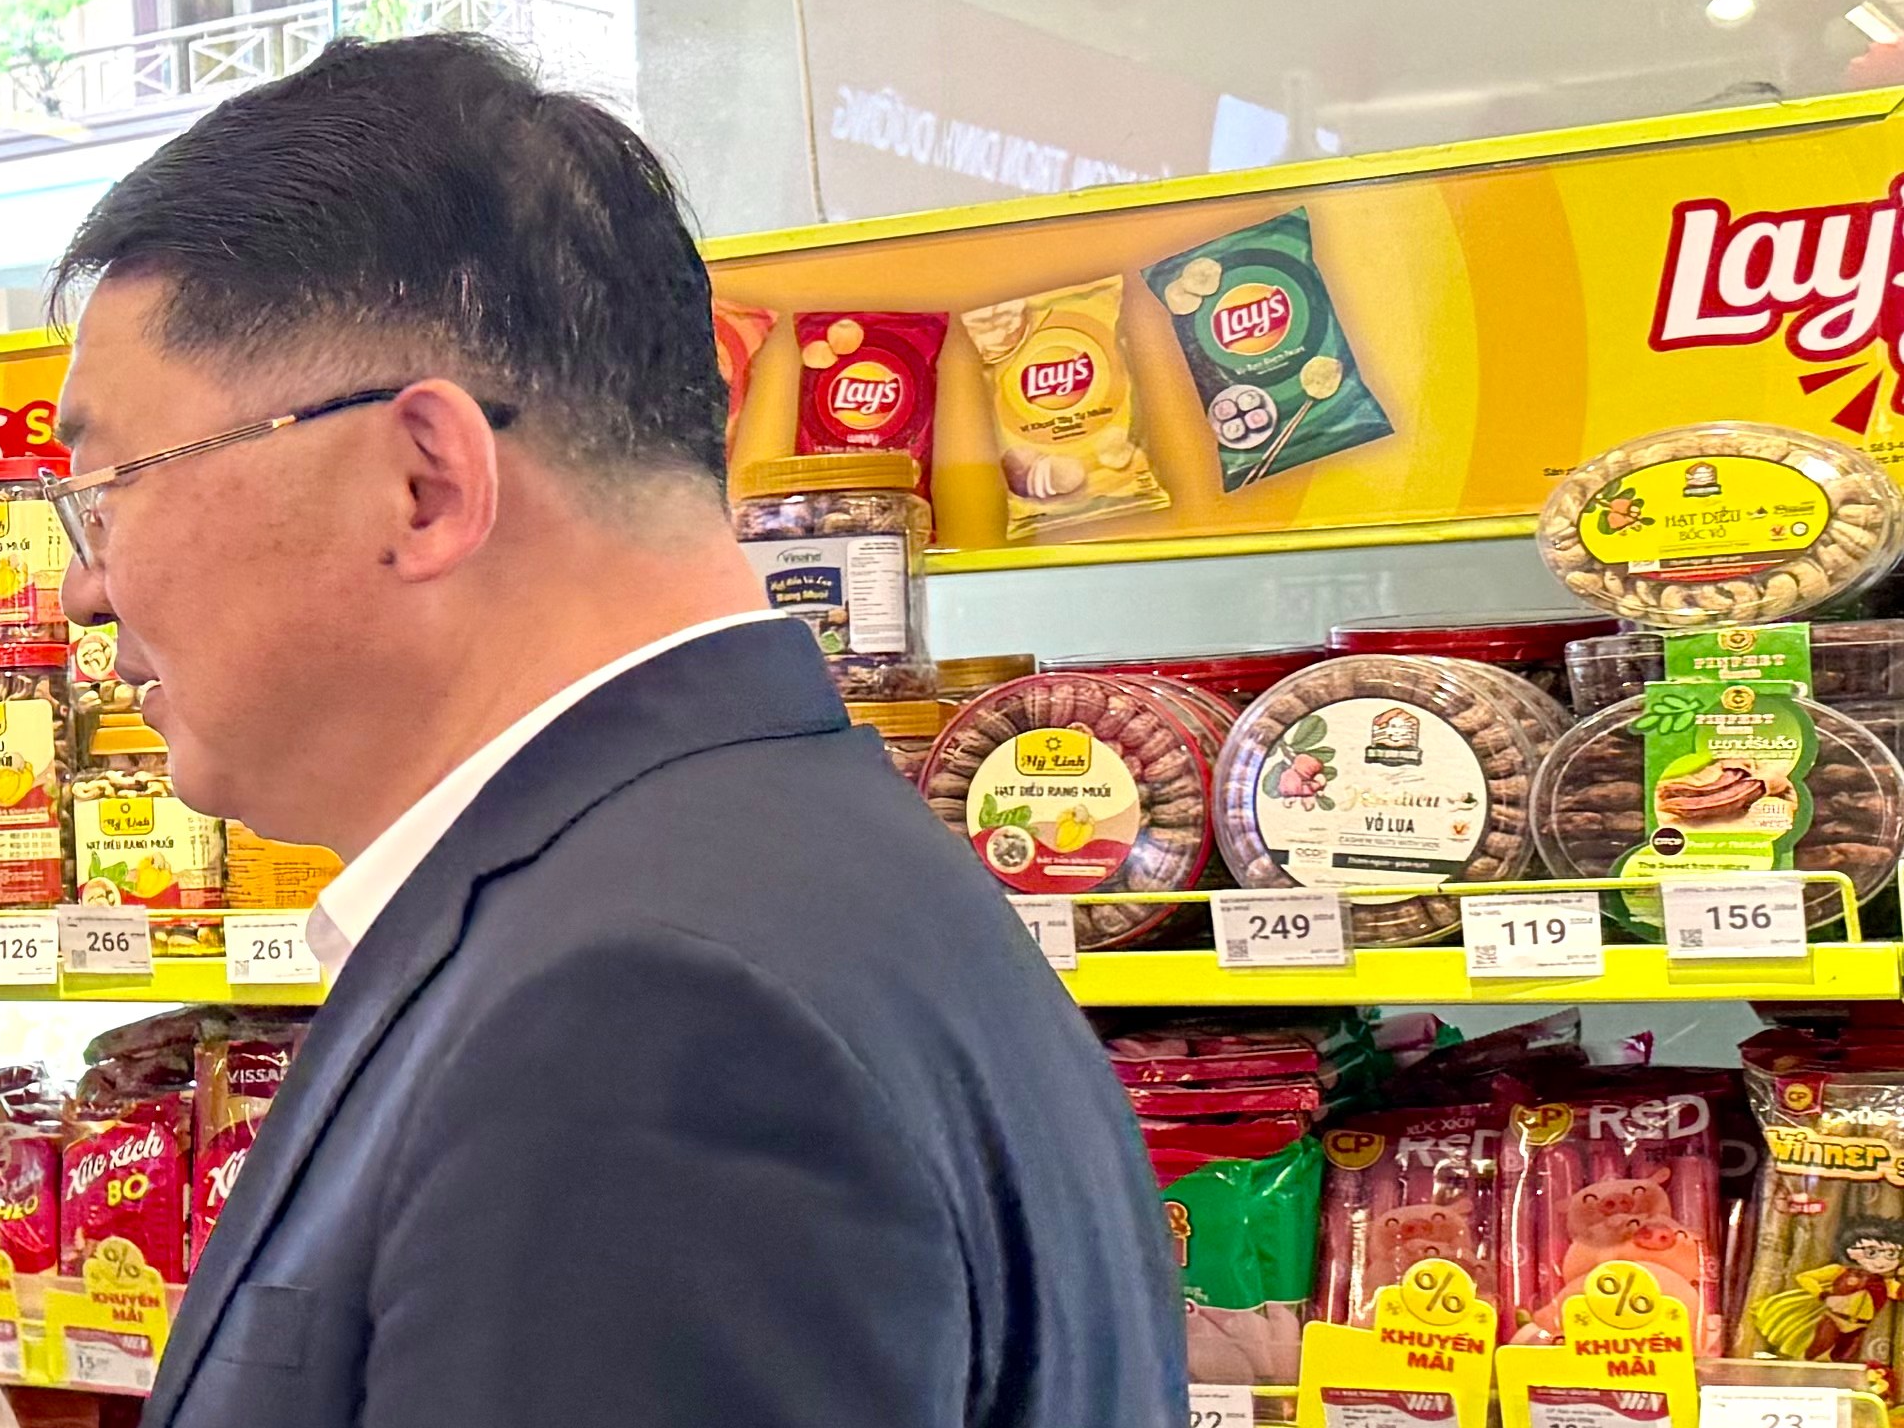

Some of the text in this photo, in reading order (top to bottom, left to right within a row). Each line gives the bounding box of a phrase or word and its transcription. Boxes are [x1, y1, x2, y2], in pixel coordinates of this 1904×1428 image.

[1661, 184, 1904, 351] Lay
[1249, 913, 1311, 941] 249
[1705, 903, 1773, 931] 156
[86, 931, 130, 953] 266
[1501, 917, 1568, 947] 119
[251, 939, 295, 961] 261
[1330, 1132, 1376, 1154] CP
[106, 1173, 150, 1208] BÒ
[92, 1290, 161, 1310] KHUYẾN
[1380, 1326, 1485, 1356] KHUYẾN
[1575, 1330, 1684, 1356] KHUYẾN
[1407, 1350, 1455, 1373] MÃI
[1607, 1356, 1657, 1378] MÃI
